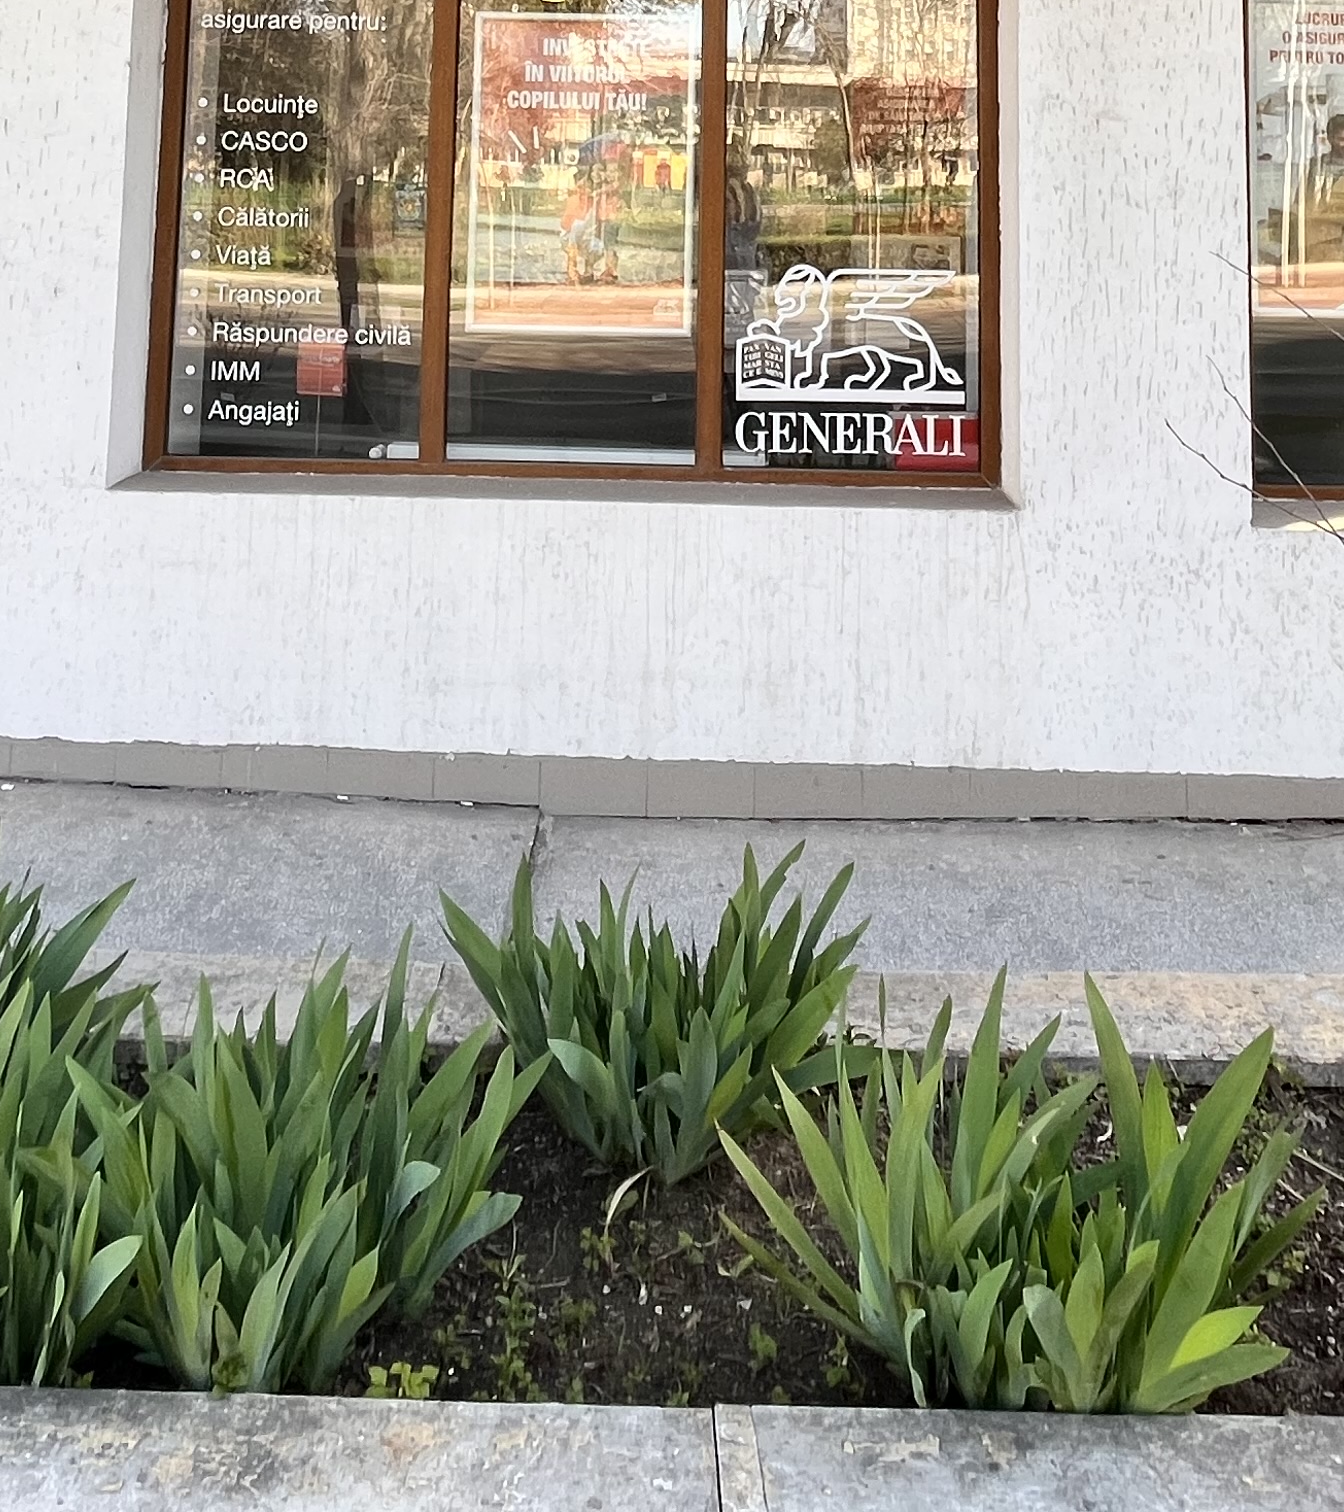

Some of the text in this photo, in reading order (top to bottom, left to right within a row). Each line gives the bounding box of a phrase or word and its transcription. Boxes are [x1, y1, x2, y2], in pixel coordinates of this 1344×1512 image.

[201, 9, 388, 34] asigurare pentru:
[507, 90, 601, 110] COPILULUI
[221, 130, 308, 151] CASCO
[220, 168, 272, 189] RCA
[217, 206, 309, 228] Călătorii
[215, 283, 322, 308] Transport
[212, 322, 411, 346] Răspundere civilă
[211, 361, 260, 381] IMM
[735, 411, 966, 457] GENERALI
